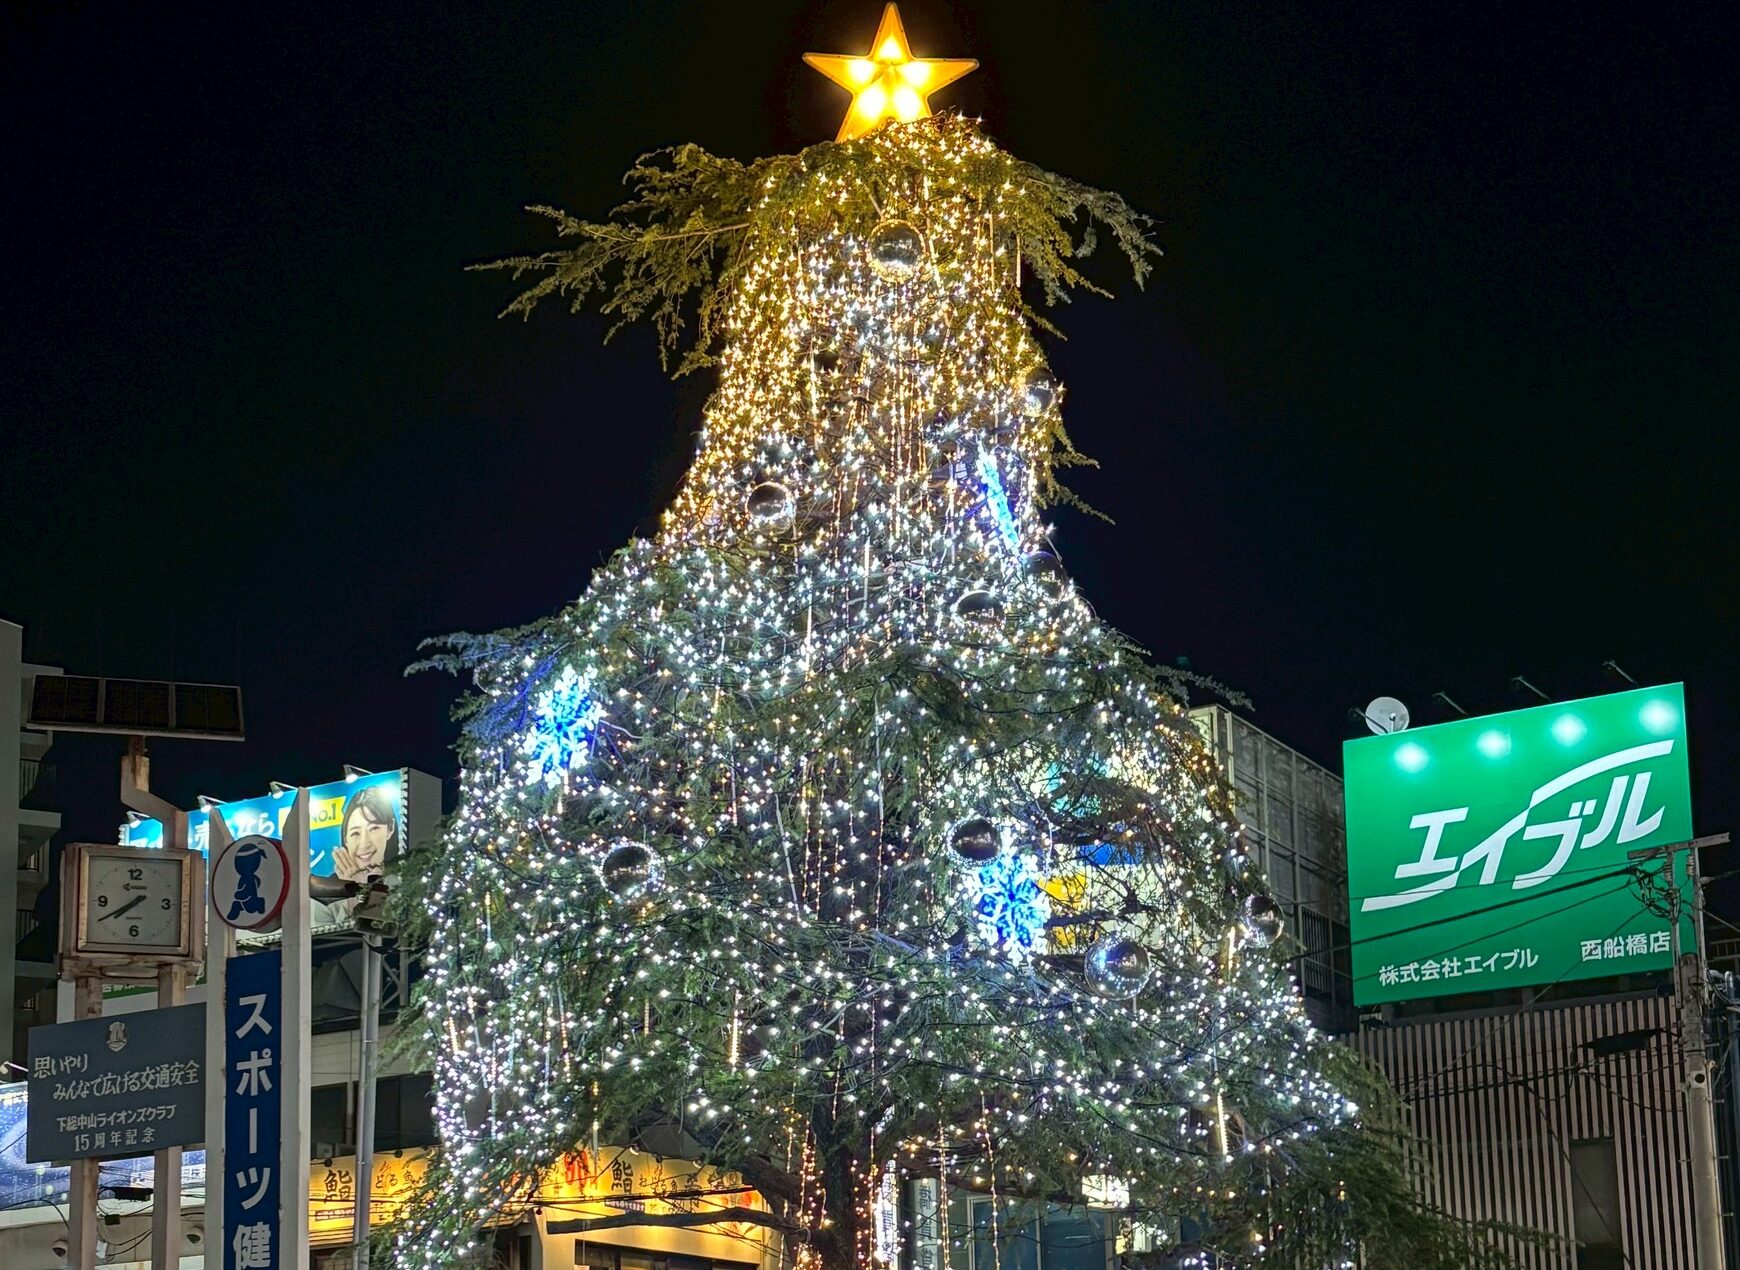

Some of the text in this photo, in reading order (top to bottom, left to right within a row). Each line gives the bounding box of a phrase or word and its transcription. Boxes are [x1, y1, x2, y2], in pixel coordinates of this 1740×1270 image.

[1361, 740, 1675, 912] エイブル
[127, 868, 143, 881] 12
[98, 895, 108, 907] 9
[161, 898, 171, 910] 3
[129, 925, 139, 937] 6
[1581, 930, 1671, 962] 西船橋店
[1378, 948, 1539, 986] 株式会社エイブル
[33, 1053, 89, 1079] 思いやり
[52, 1059, 200, 1101] みんなで広げる交通安全
[56, 1104, 177, 1133] 下総中山ライオンズクラブ
[232, 993, 273, 1270] スポーツ健
